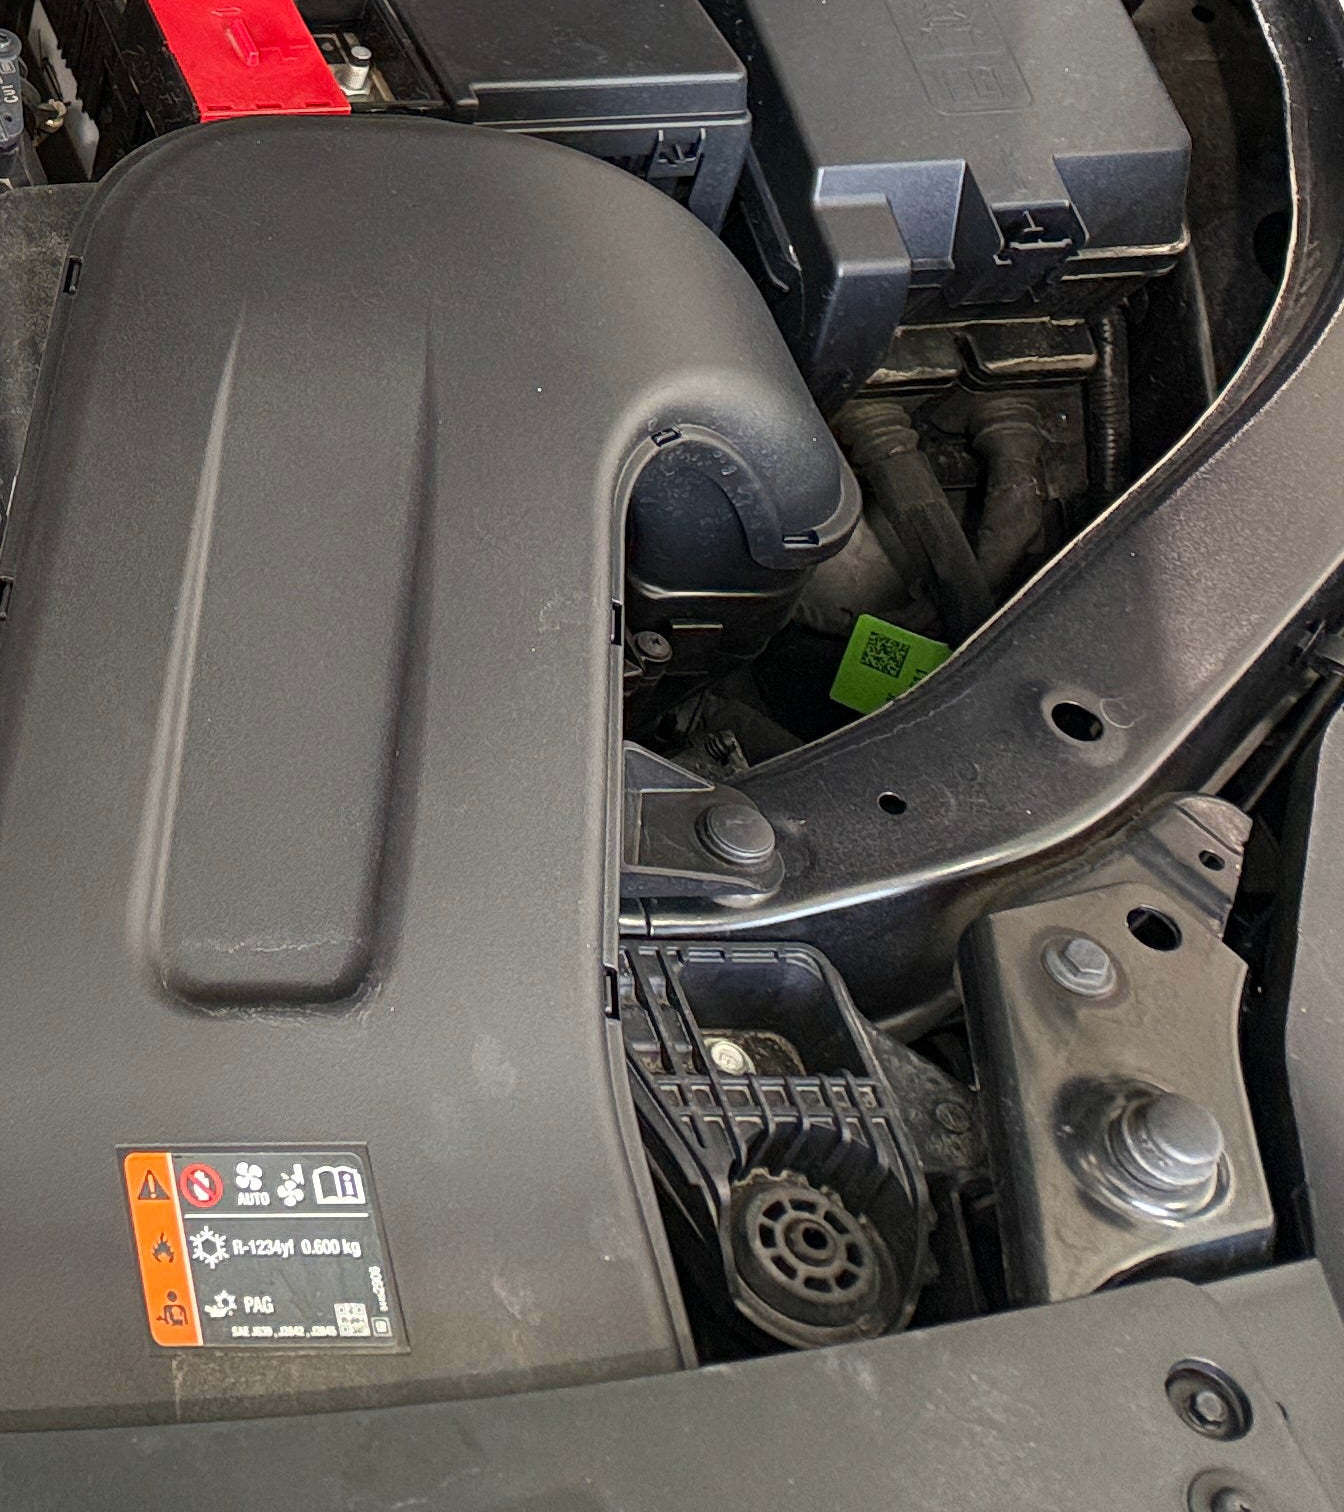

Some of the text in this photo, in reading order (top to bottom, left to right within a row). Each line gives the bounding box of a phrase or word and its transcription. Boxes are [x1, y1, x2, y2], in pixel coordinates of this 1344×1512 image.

[237, 1191, 271, 1206] AUTO
[232, 1238, 362, 1258] R-1234yf 0.600 kg
[243, 1295, 274, 1314] PAG
